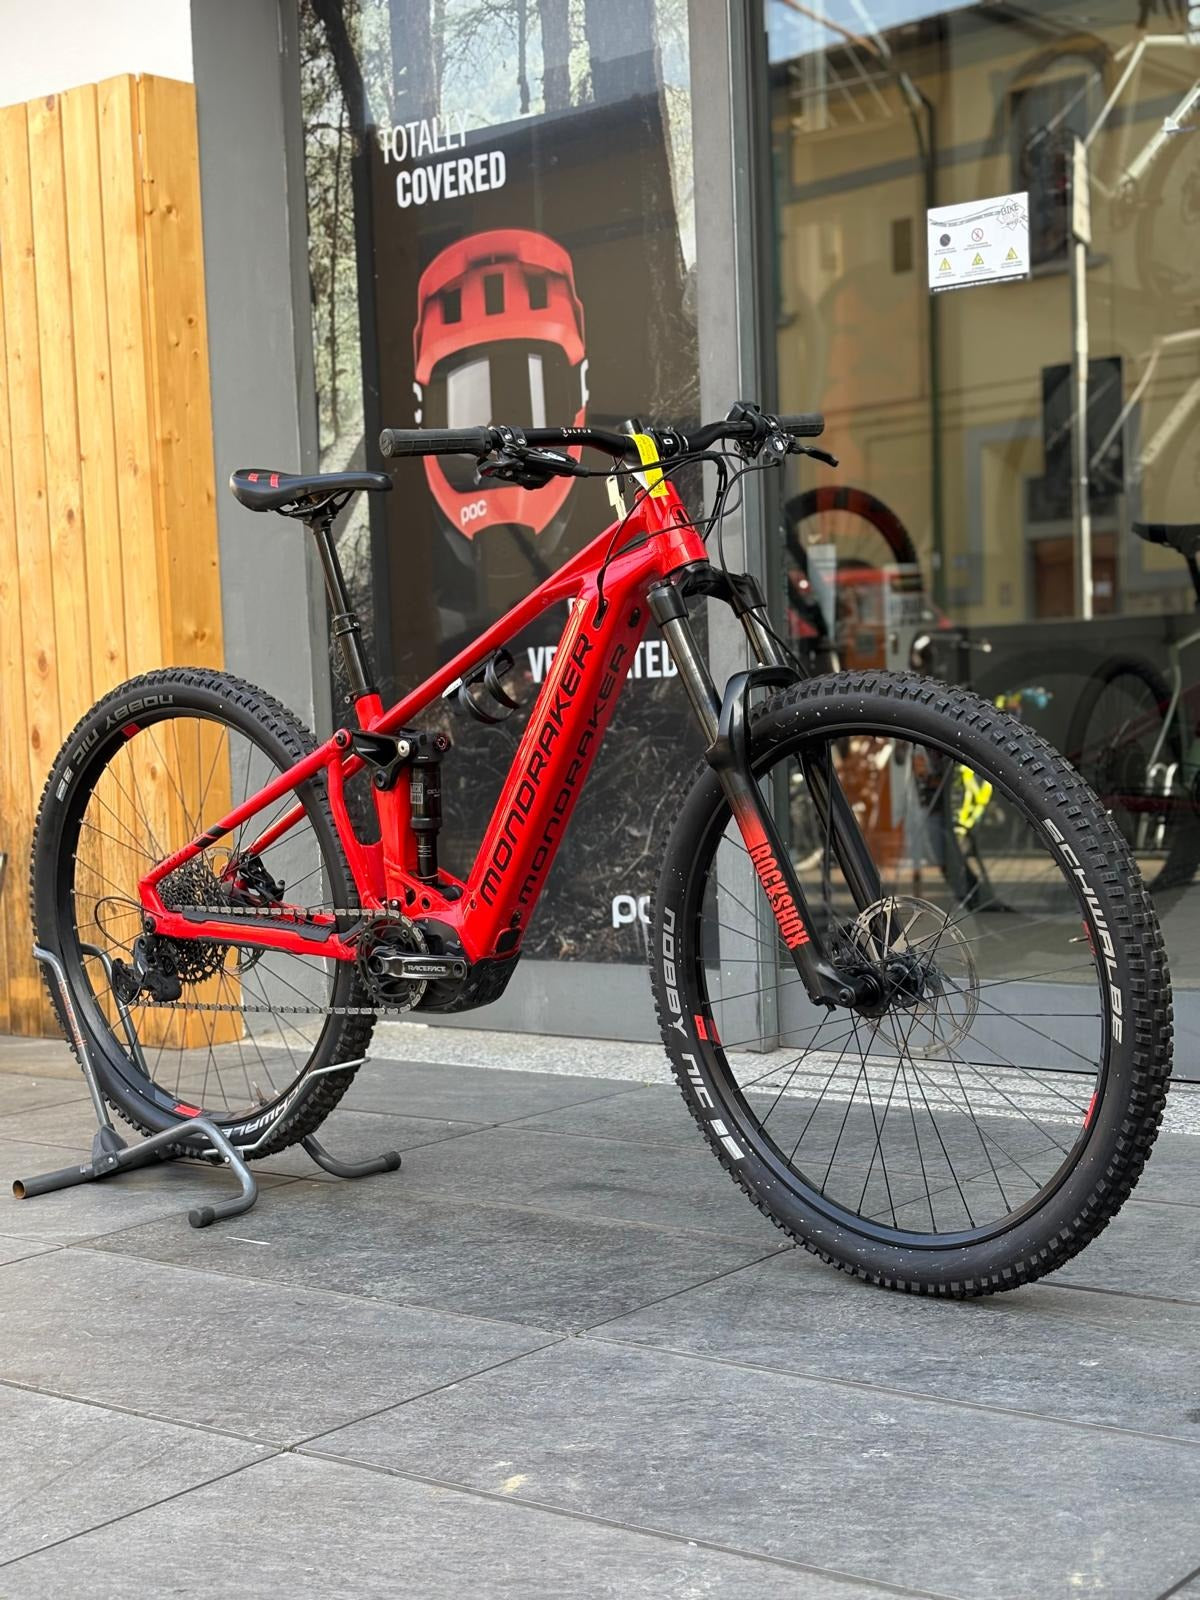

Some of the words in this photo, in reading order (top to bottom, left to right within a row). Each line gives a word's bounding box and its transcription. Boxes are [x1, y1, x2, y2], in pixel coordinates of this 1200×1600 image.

[379, 112, 468, 164] TOTALLY
[396, 150, 507, 208] COVERED
[460, 499, 488, 526] poc
[105, 694, 174, 730] NOBBY
[73, 728, 100, 765] NIC
[479, 633, 595, 907] MONDRAKER
[518, 642, 628, 906] MONDRAKER
[612, 894, 652, 929] po
[750, 844, 811, 950] ROCKSHOX
[1042, 818, 1123, 1044] SCHWALBE
[407, 965, 447, 973] RACEFACE
[662, 906, 689, 1038] NOBBY
[681, 1053, 715, 1109] NIC
